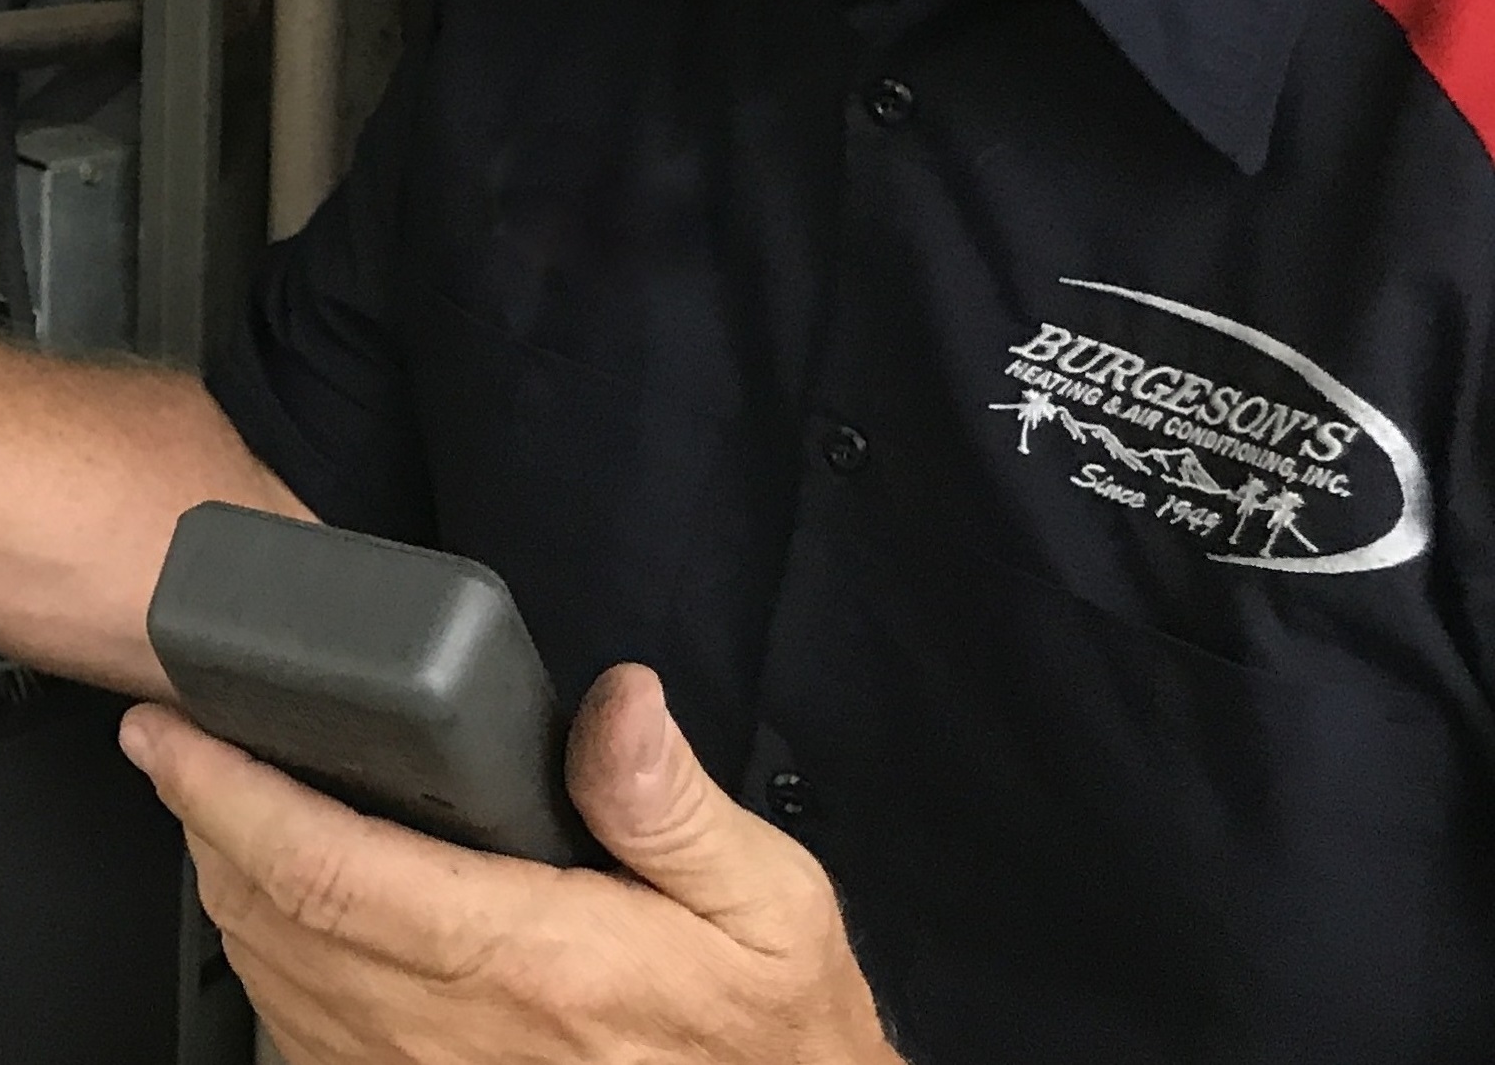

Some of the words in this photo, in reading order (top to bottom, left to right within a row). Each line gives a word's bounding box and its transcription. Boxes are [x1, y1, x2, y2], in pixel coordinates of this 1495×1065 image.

[1004, 359, 1104, 406] HEATING
[1163, 416, 1299, 484] CONDITIONING,
[1300, 464, 1353, 498] INC.
[1008, 322, 1359, 462] BURGESON'S
[1070, 463, 1146, 508] Since
